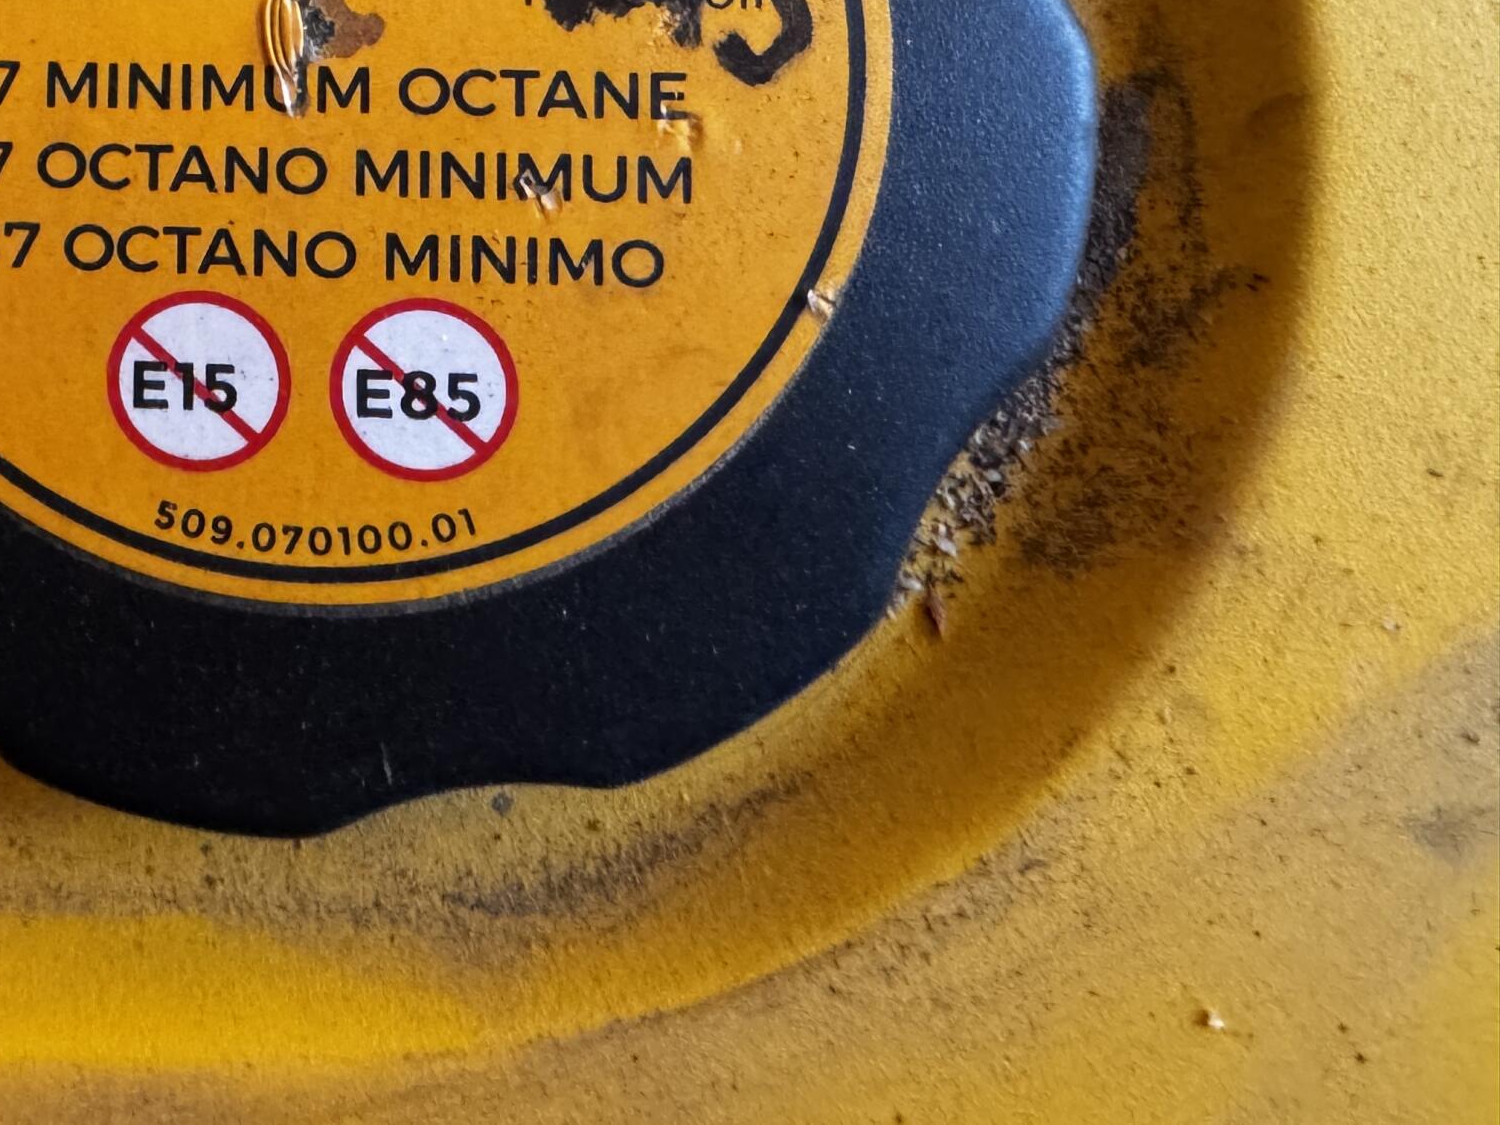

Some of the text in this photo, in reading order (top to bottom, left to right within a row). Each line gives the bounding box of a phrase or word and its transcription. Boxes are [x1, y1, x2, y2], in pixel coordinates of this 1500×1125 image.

[46, 61, 370, 114] MINIMUM
[399, 68, 688, 120] OCTANE
[37, 142, 328, 195] OCTANO
[355, 149, 692, 204] MINIMUM
[63, 223, 357, 279] OCTANO
[385, 232, 664, 288] MINIMO
[132, 360, 238, 415] E15
[356, 368, 481, 423] E85
[154, 500, 477, 556] 509.070100.01
